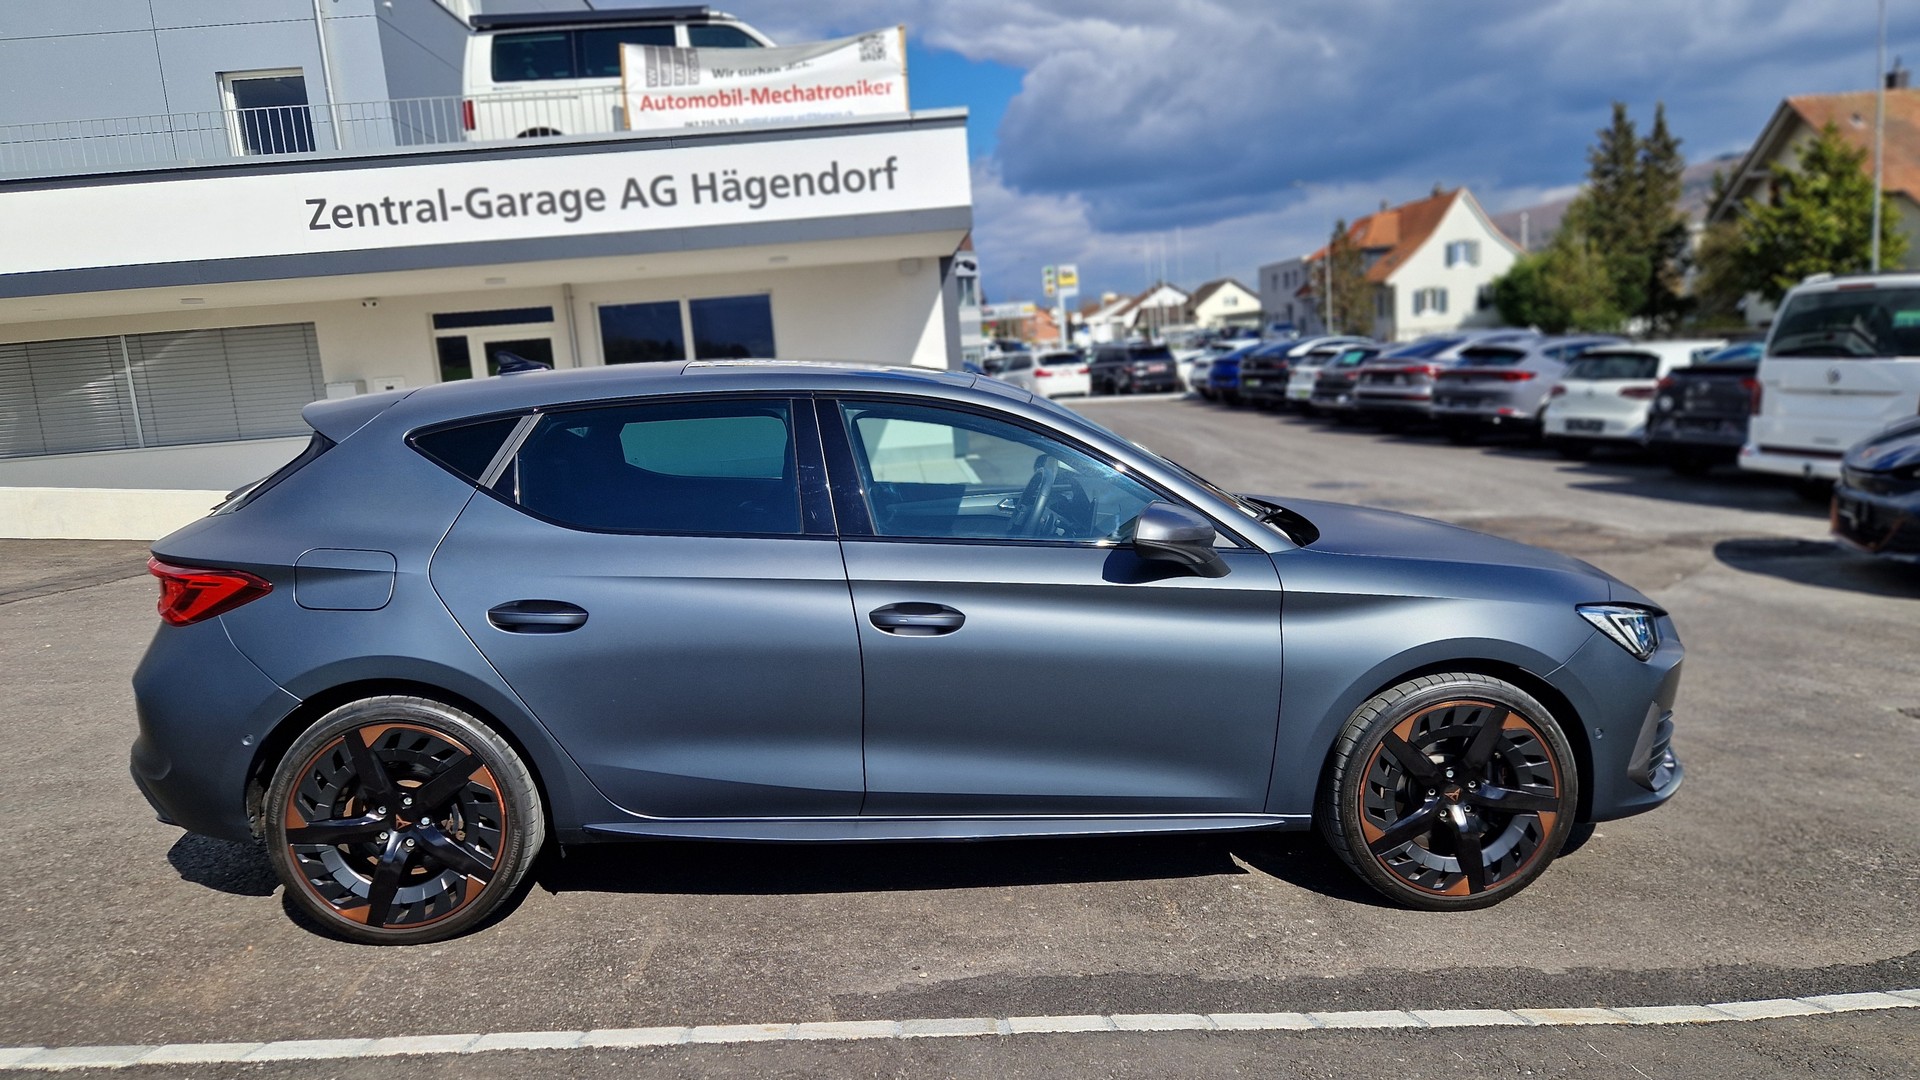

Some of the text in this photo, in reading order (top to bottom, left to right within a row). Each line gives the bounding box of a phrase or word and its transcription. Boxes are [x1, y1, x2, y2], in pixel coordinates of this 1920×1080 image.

[711, 67, 734, 79] Wir
[639, 79, 893, 112] Automobil-Mechatroniker
[306, 156, 898, 231] Zentral-Garage AG Hägendorf
[499, 828, 523, 884] BRIDGESTONE
